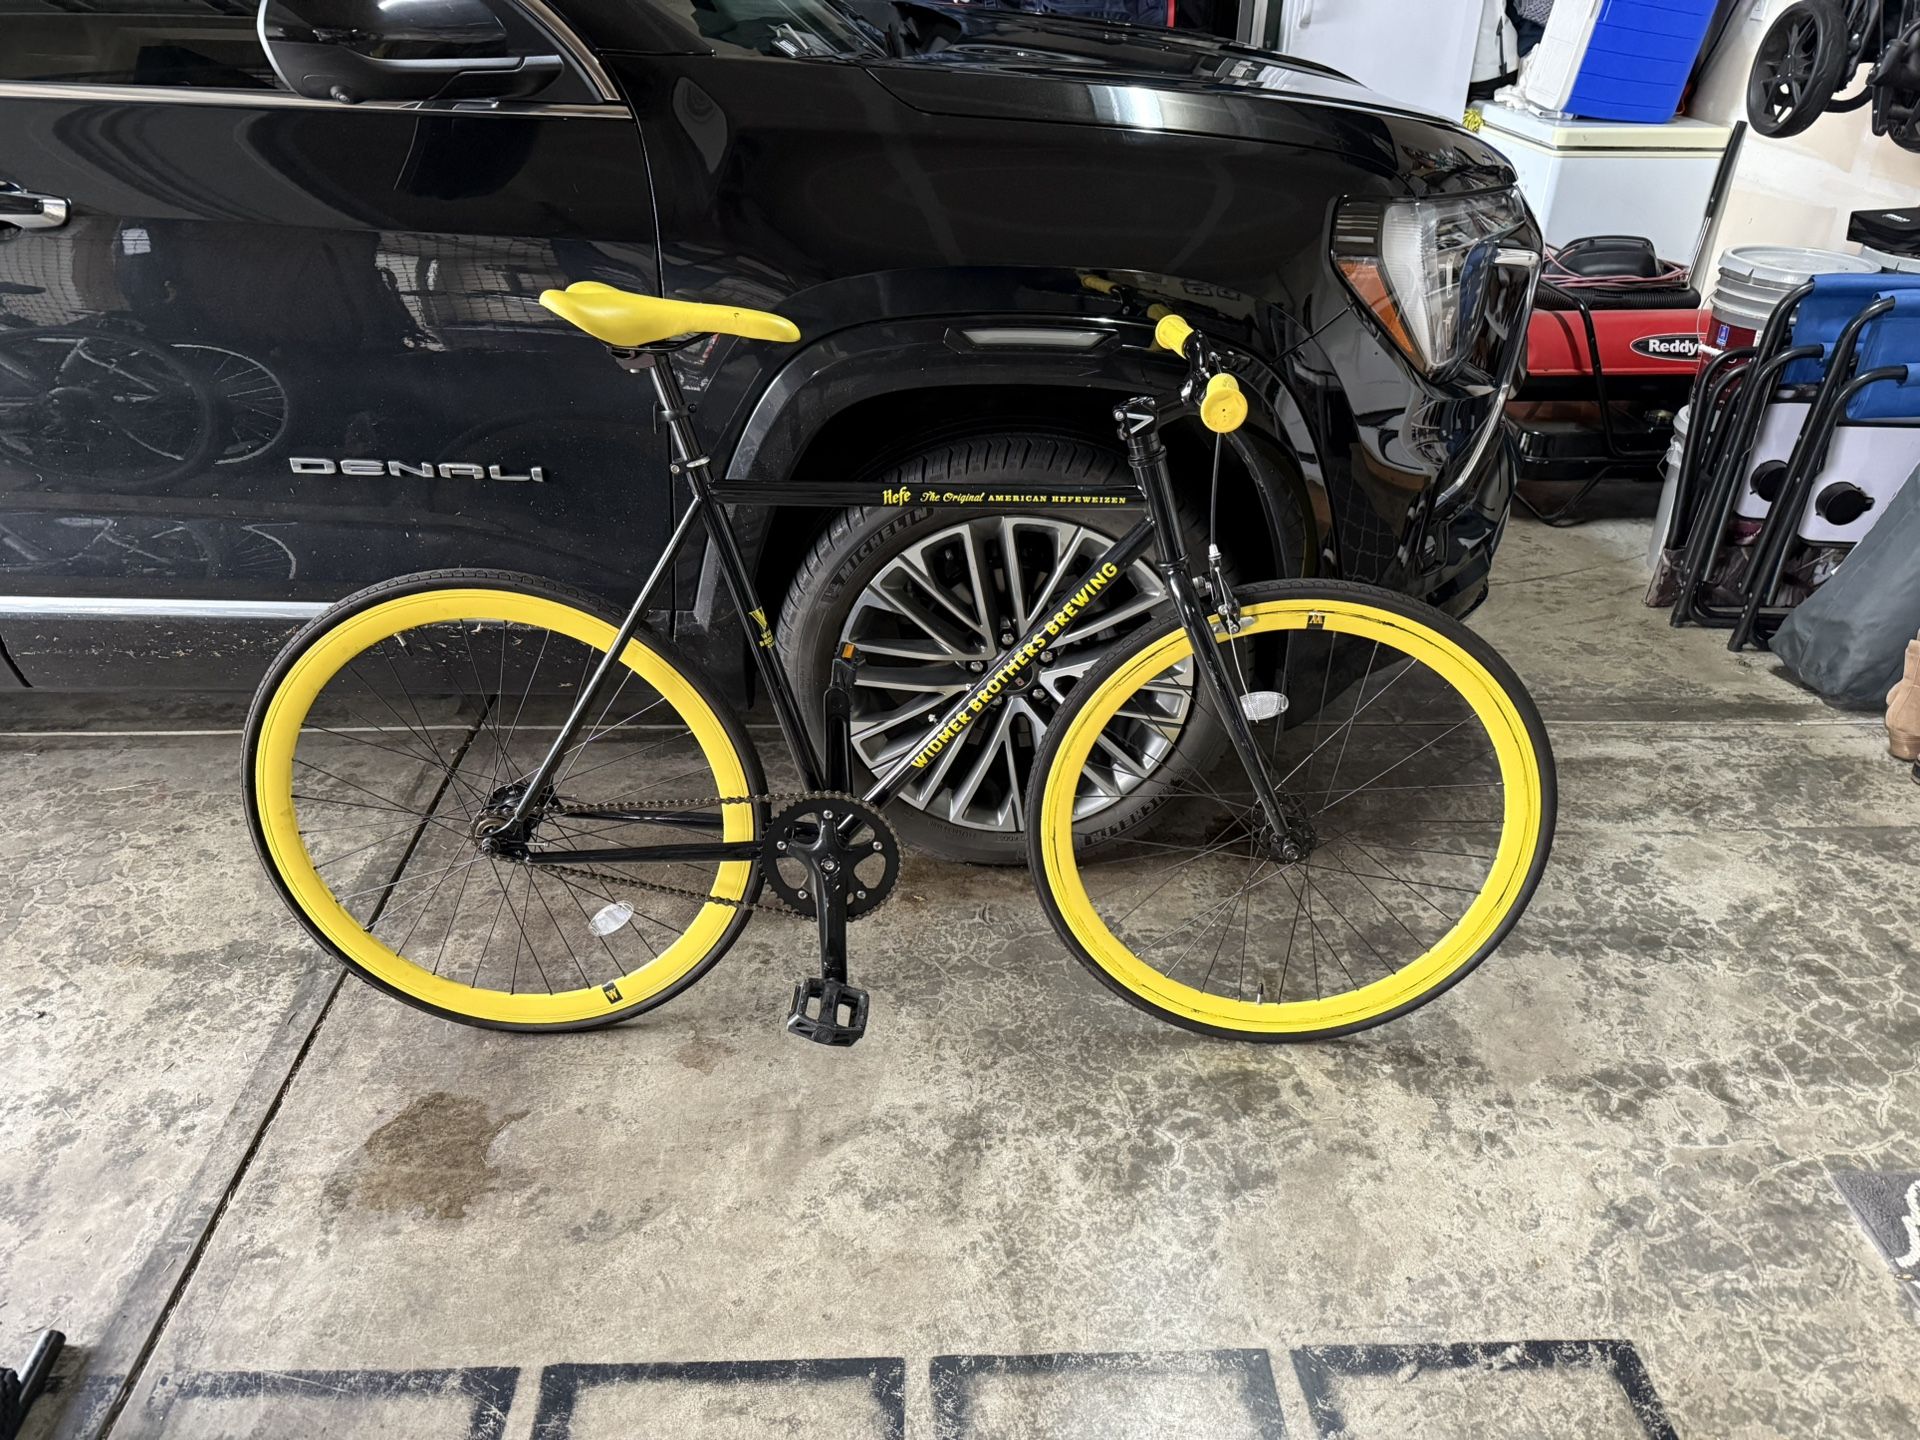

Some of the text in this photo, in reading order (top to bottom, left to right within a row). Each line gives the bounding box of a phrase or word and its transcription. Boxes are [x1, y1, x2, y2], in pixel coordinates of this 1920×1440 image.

[289, 457, 544, 482] DENALI
[882, 486, 1127, 506] Hefe The Original AMERICAN HEFEWEIZEN
[838, 506, 929, 585] MICHELIN
[910, 711, 972, 769] WIDMER
[968, 633, 1047, 713] BROTHERS
[1044, 562, 1119, 636] BREWING
